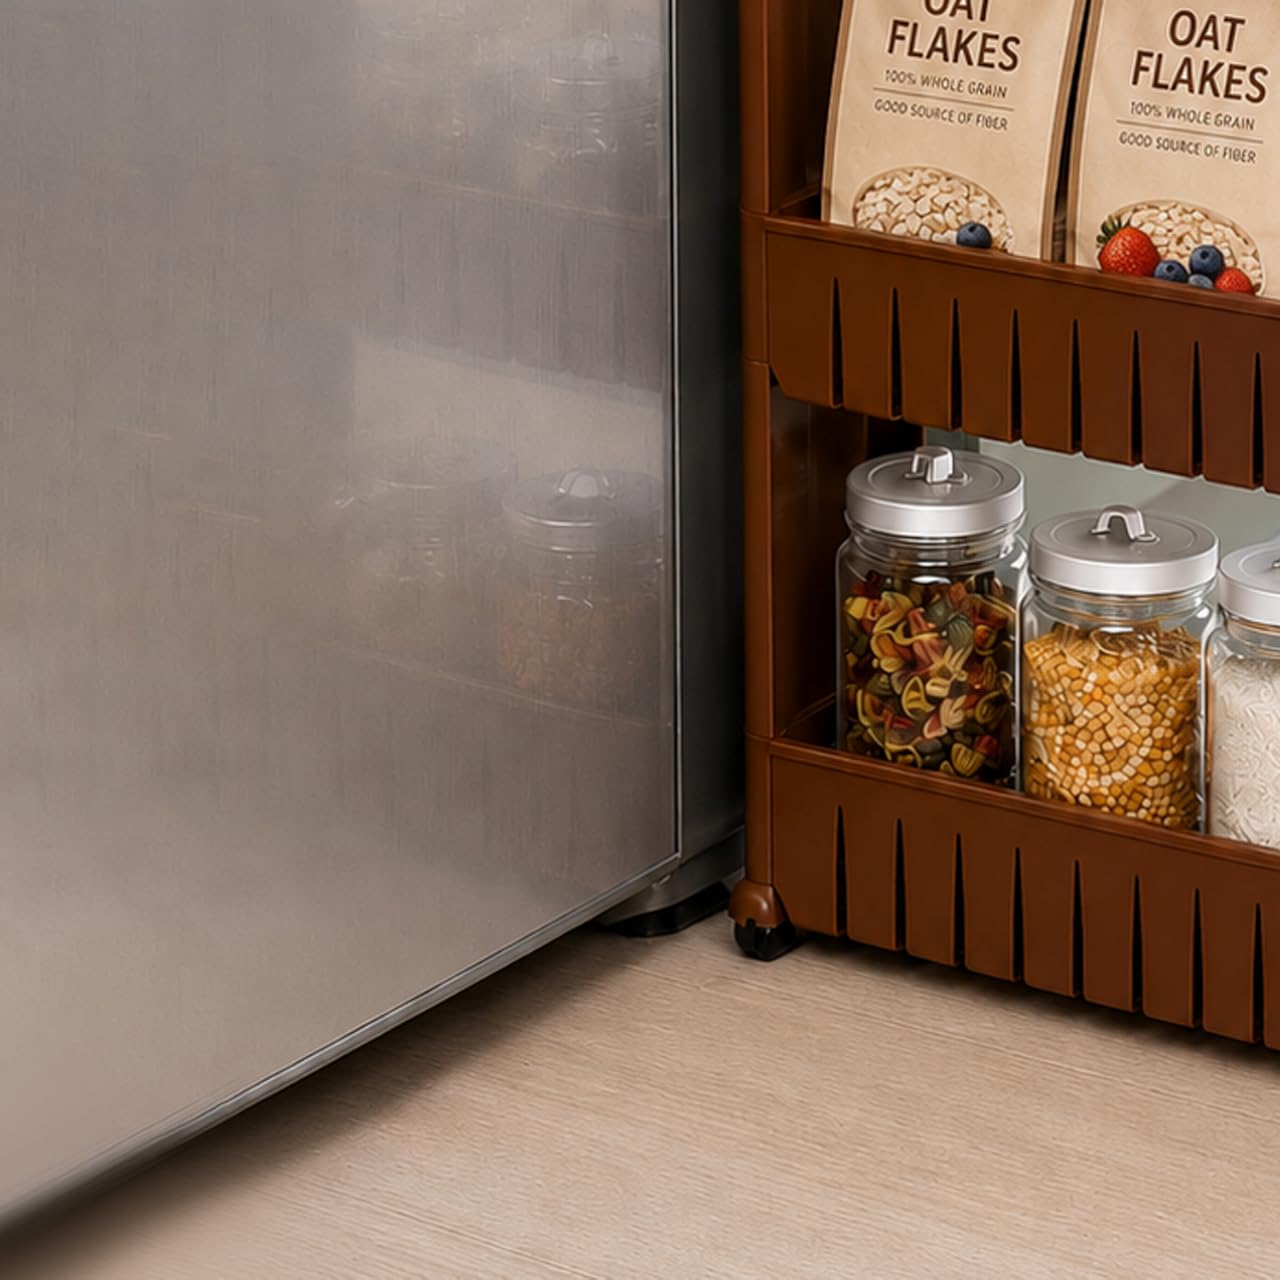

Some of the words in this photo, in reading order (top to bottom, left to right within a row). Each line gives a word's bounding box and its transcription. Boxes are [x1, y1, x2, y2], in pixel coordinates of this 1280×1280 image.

[887, 19, 1021, 72] FLAKES
[1168, 9, 1246, 53] OAT
[885, 69, 916, 85] 100%
[920, 75, 964, 93] WHOLE
[968, 81, 1007, 99] GRAIN
[1131, 50, 1269, 104] FLAKES
[874, 99, 908, 114] GOOD
[910, 103, 955, 123] SOURCE
[958, 111, 974, 125] OF
[976, 113, 1008, 131] FIBER
[1131, 101, 1162, 117] 100%
[1166, 106, 1211, 125] WHOLE
[1214, 112, 1255, 131] GRAIN
[1119, 131, 1153, 148] GOOD
[1156, 136, 1201, 156] SOURCE
[1204, 144, 1220, 158] OF
[1222, 146, 1256, 164] FIBER
